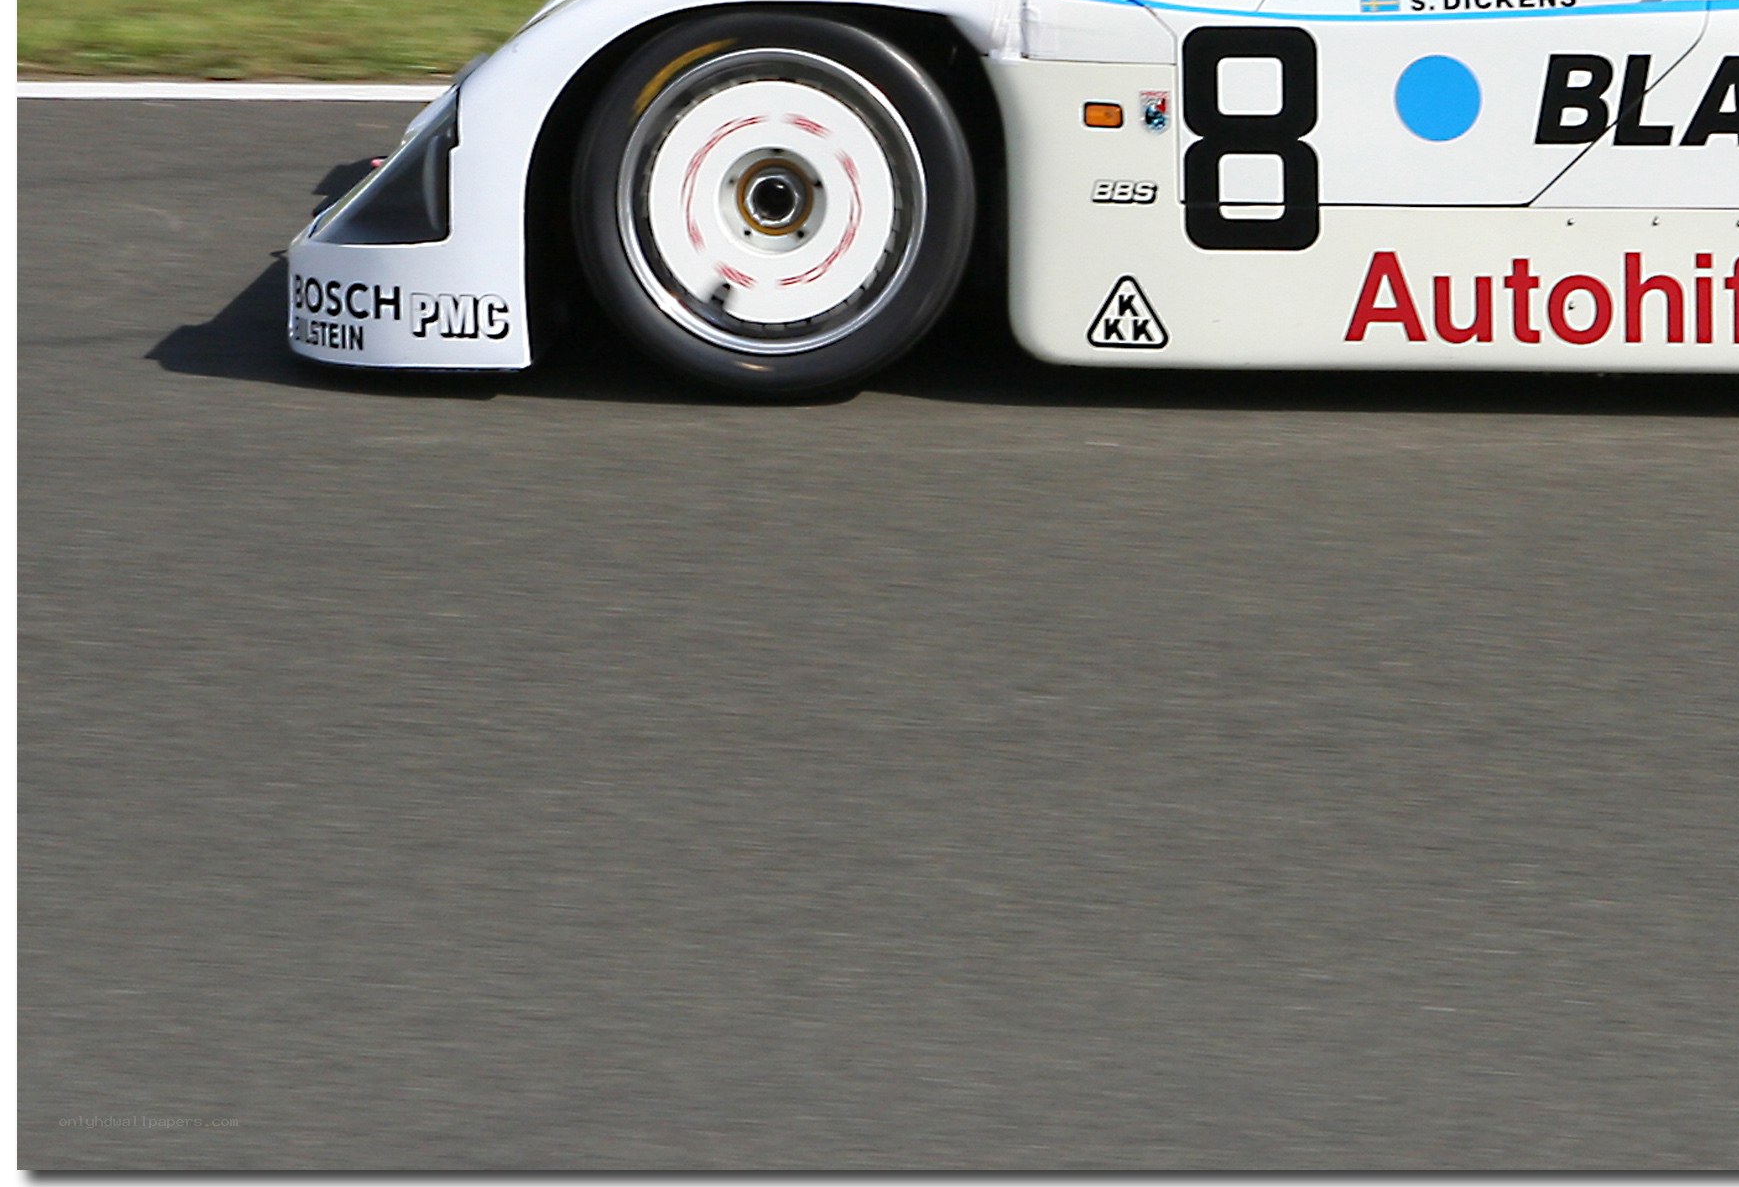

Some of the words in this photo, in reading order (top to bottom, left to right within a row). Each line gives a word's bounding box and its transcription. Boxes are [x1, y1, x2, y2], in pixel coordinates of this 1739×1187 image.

[1183, 26, 1319, 251] 8
[1091, 180, 1158, 205] BBS
[295, 274, 401, 320] BOSCH
[410, 292, 509, 339] PMC
